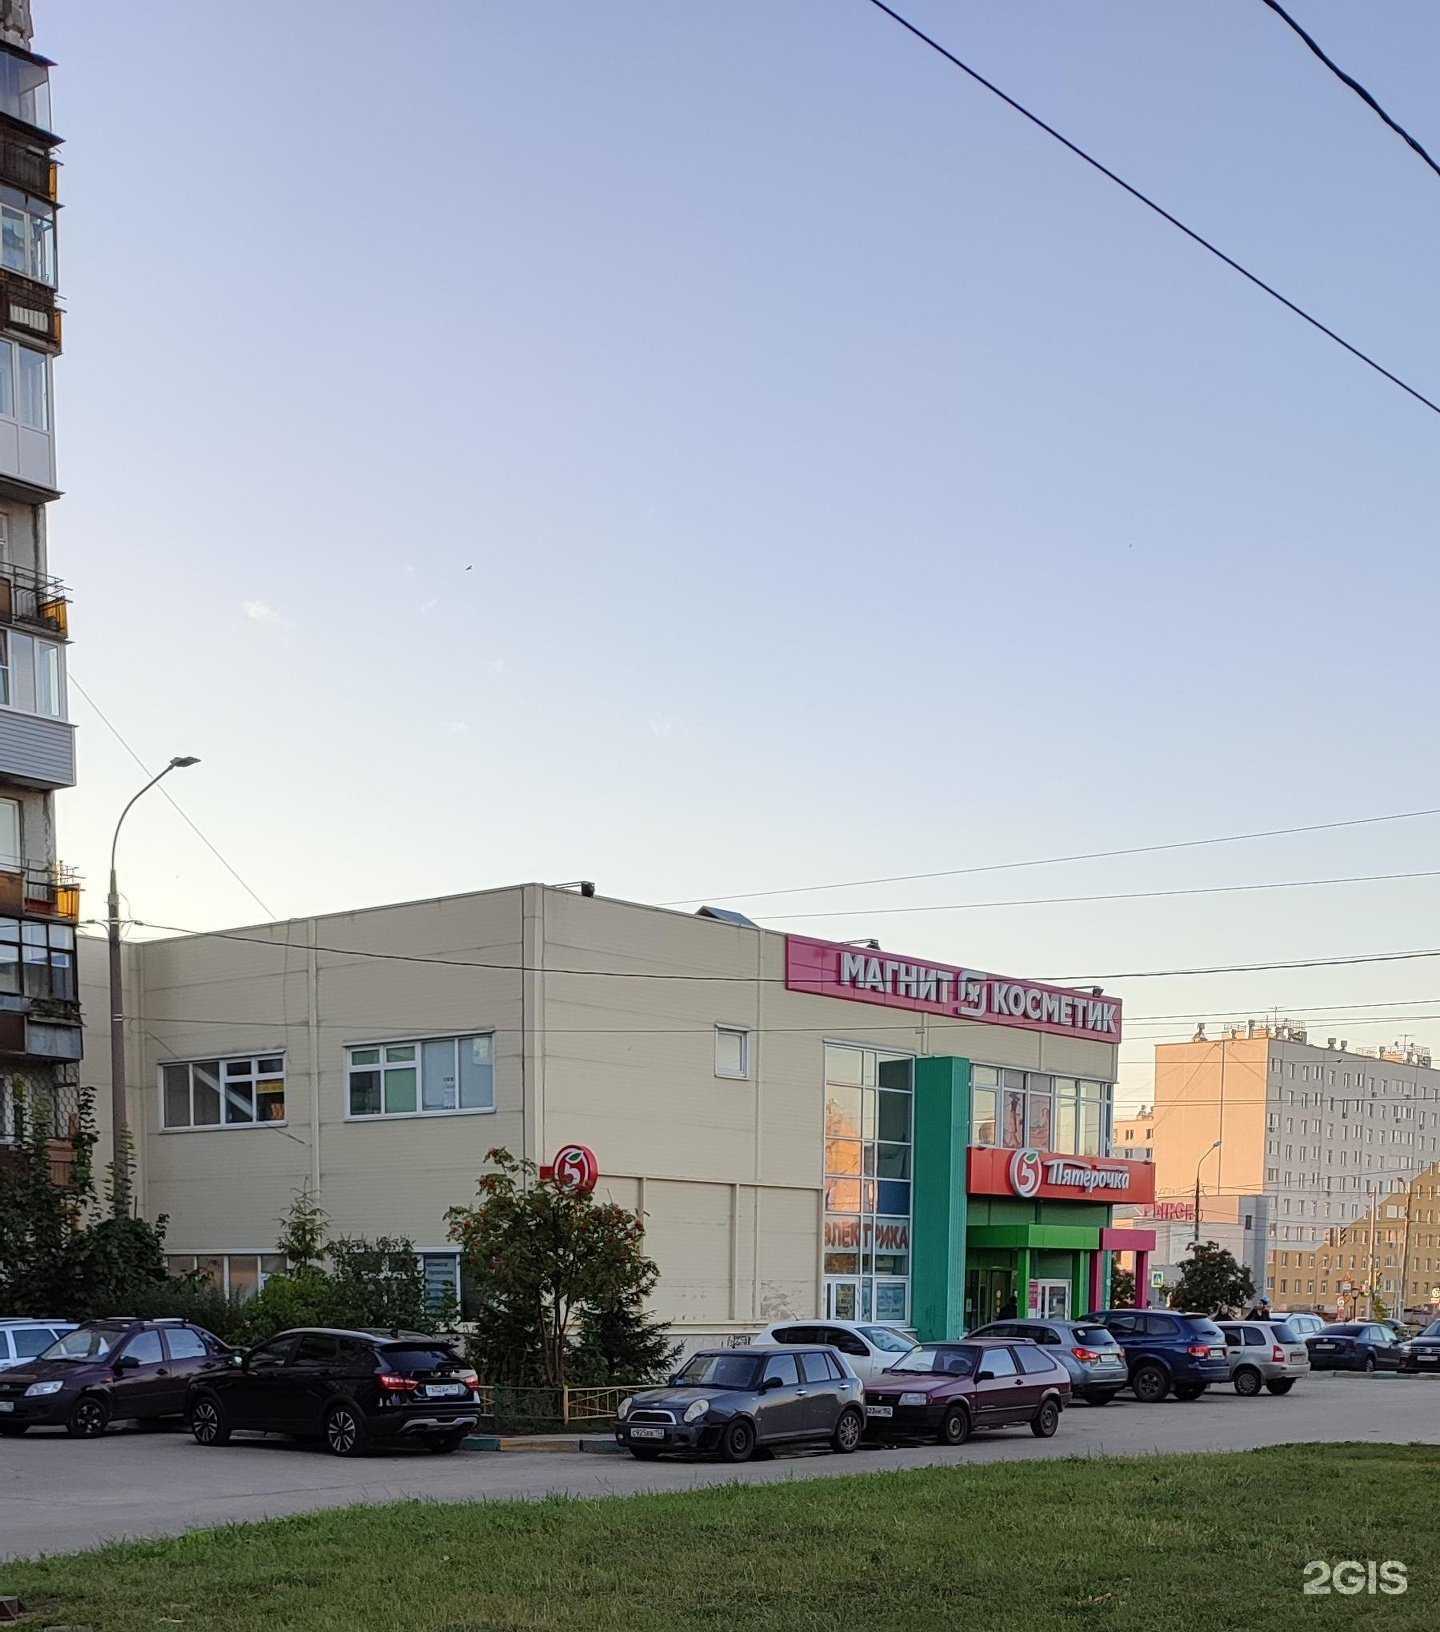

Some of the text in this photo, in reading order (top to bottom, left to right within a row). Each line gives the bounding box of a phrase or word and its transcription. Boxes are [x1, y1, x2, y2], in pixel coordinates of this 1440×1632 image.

[840, 952, 1117, 1033] МАГНИТ КОСМЕТИК
[1043, 1158, 1131, 1193] Пятерочка
[824, 1221, 909, 1249] ЭЛЕКТРИКА
